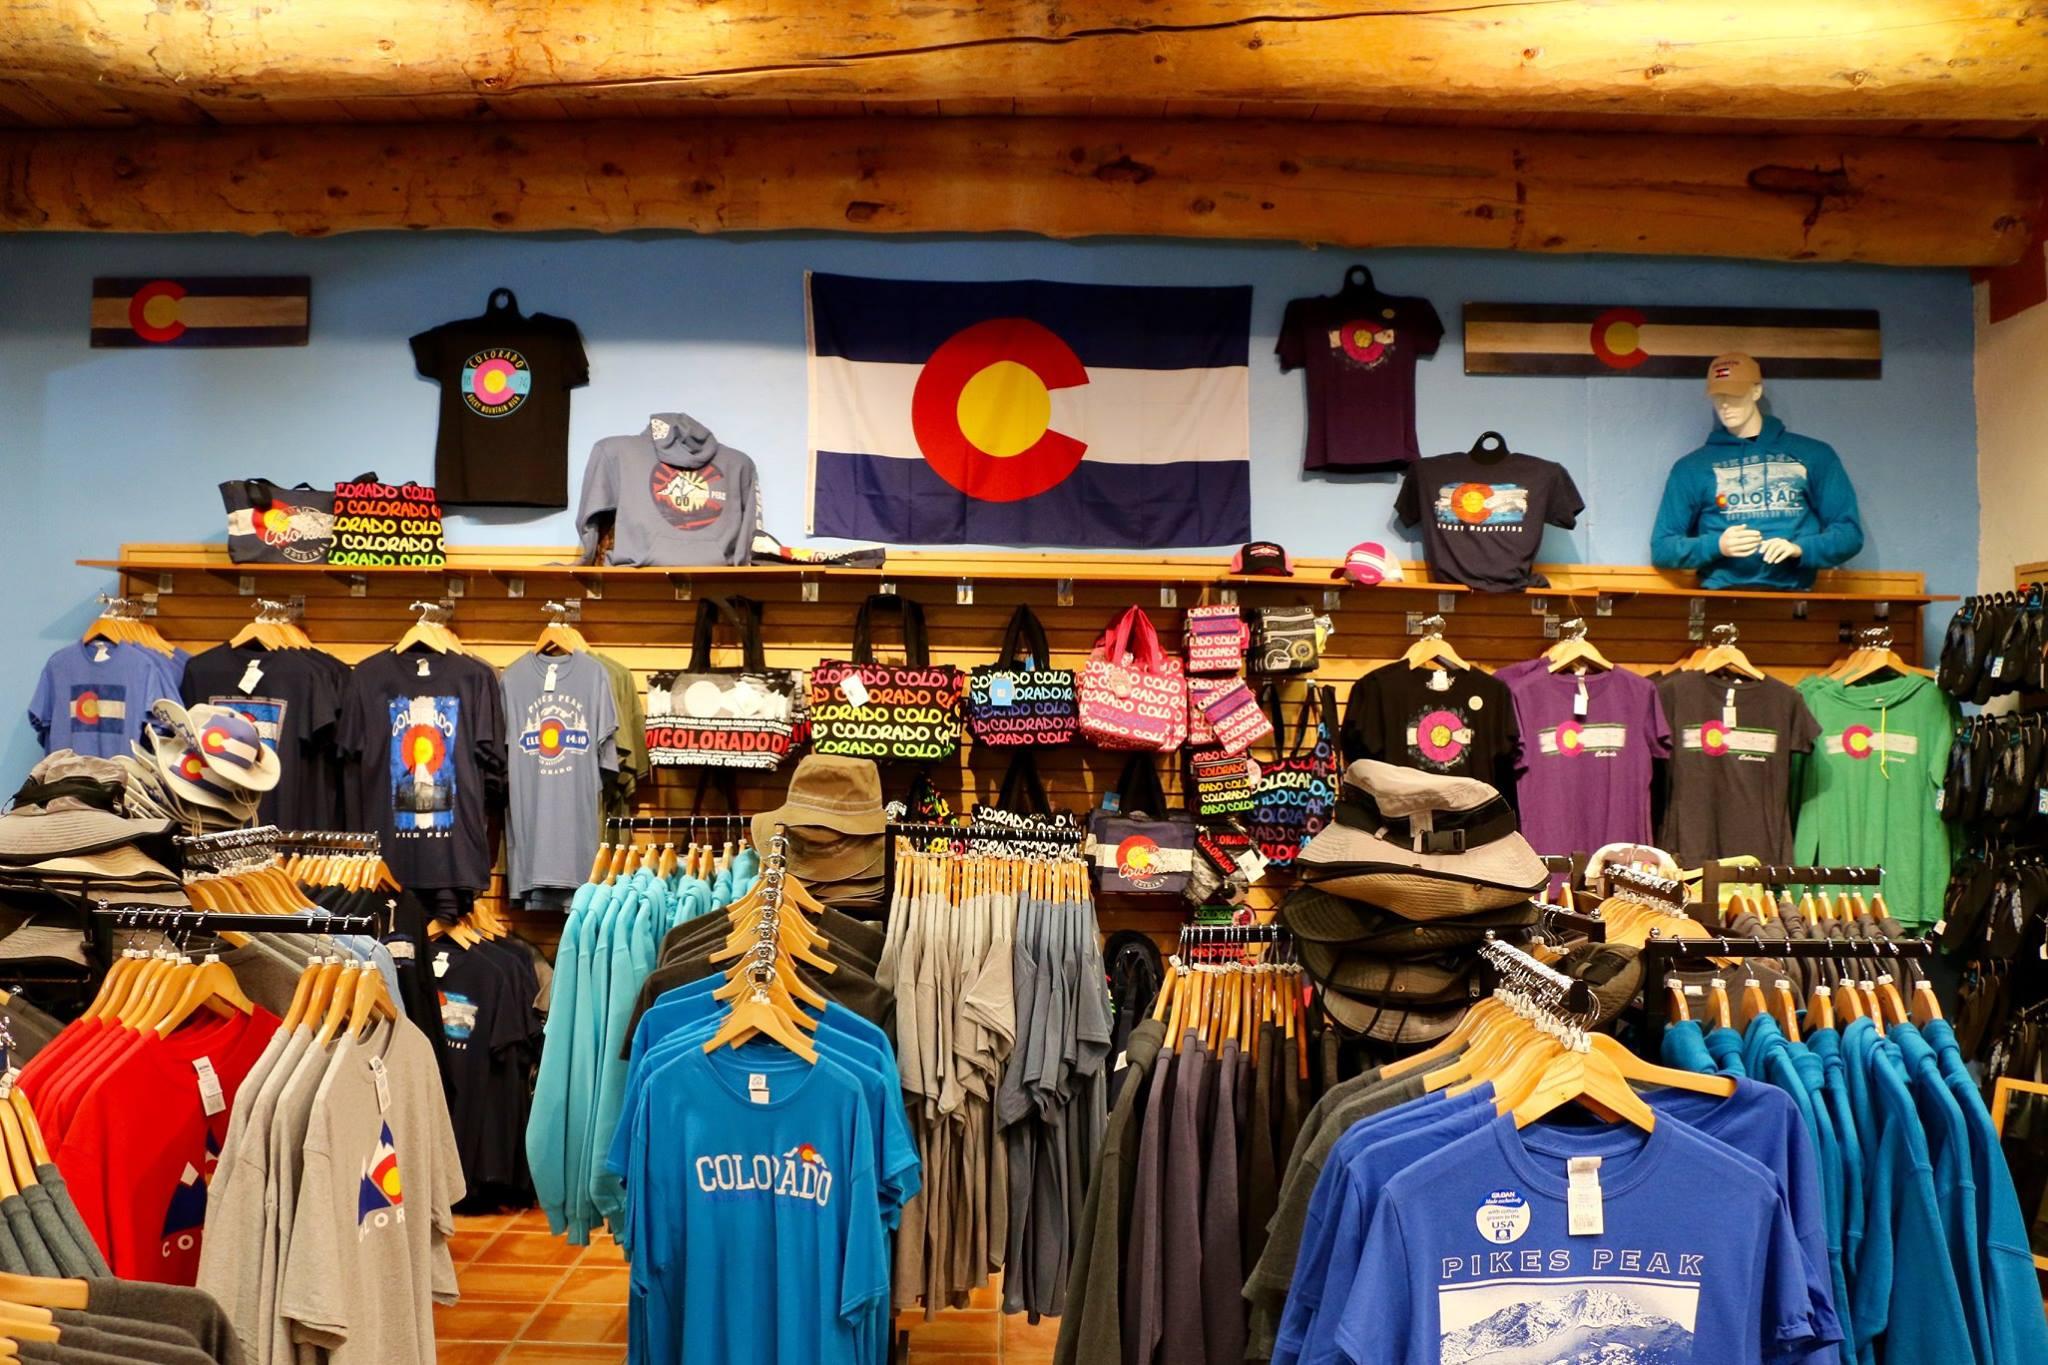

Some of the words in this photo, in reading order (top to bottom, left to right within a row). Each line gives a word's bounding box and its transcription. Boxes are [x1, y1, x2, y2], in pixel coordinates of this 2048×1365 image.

[468, 350, 525, 369] COLORADO
[347, 499, 430, 518] COLORADO
[341, 533, 434, 553] COLORADO
[831, 721, 931, 742] COLORADO
[1202, 789, 1250, 803] COLORADO
[1198, 835, 1235, 873] COLORADO
[1491, 1220, 1515, 1229] USA
[1442, 1250, 1570, 1279] PIKES
[1592, 1249, 1704, 1276] PEAK
